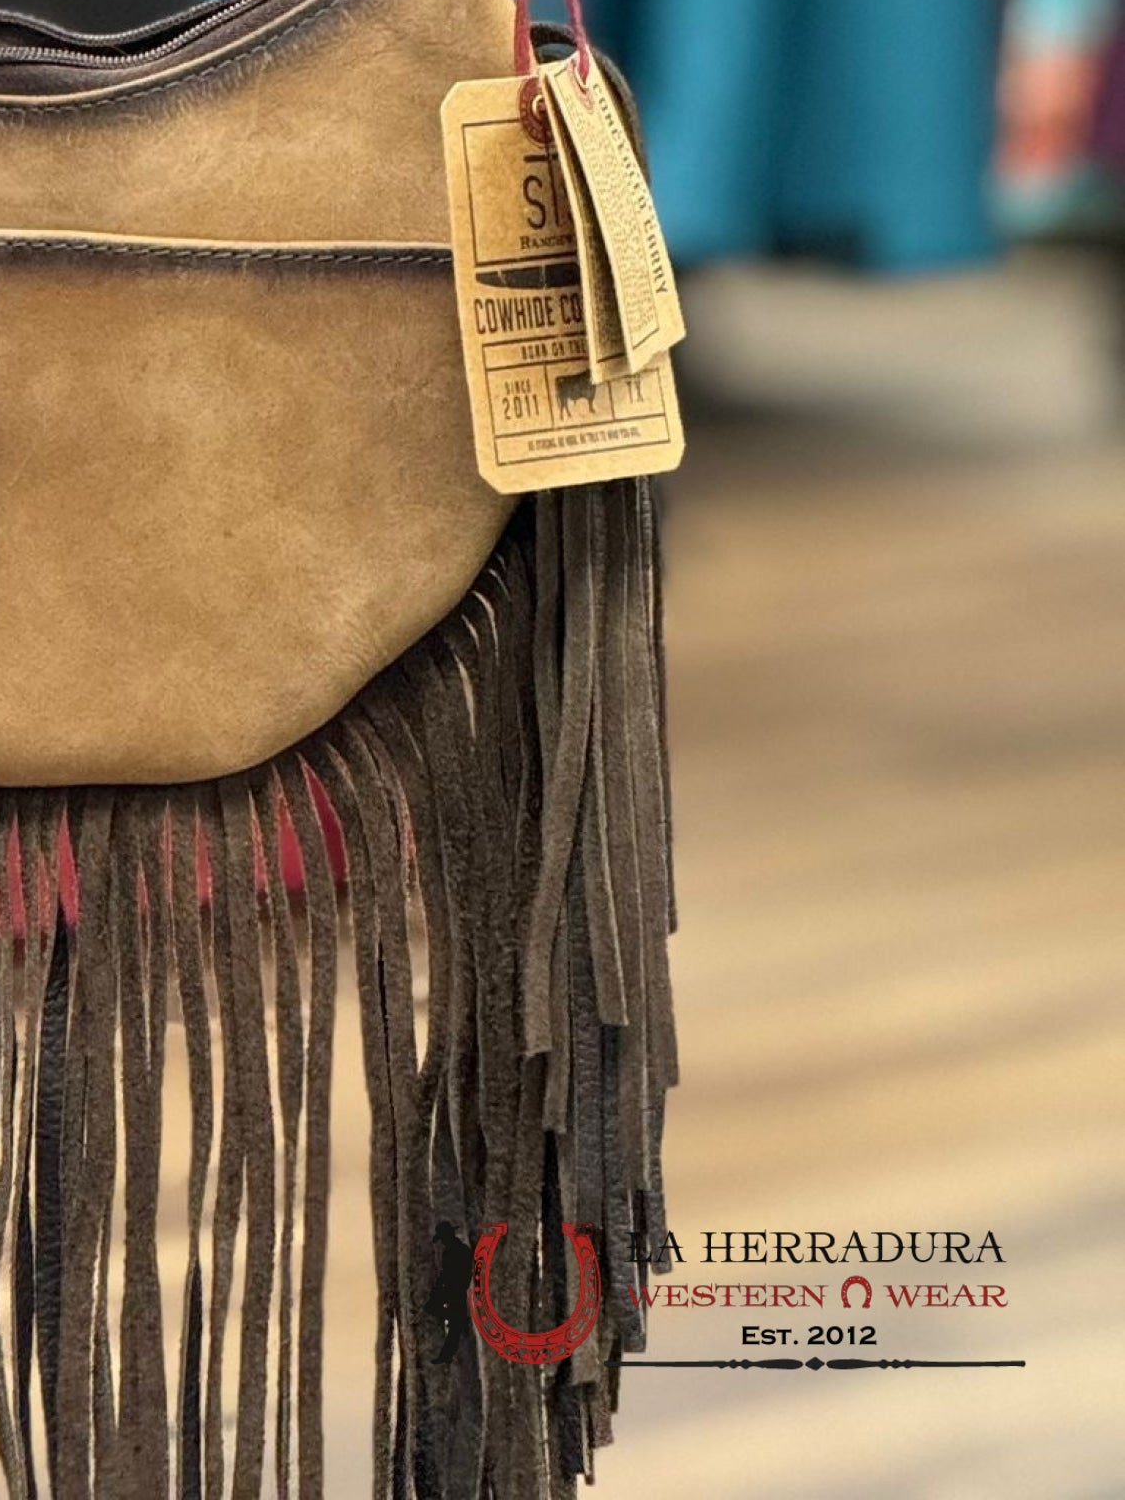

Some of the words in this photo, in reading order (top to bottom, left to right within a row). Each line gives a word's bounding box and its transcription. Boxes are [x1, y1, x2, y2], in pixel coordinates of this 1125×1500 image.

[523, 154, 574, 230] ST
[644, 218, 668, 294] CARRY
[473, 296, 556, 334] COWHIDE
[559, 293, 583, 325] CO
[502, 395, 540, 420] 2011
[504, 379, 531, 395] SINCE
